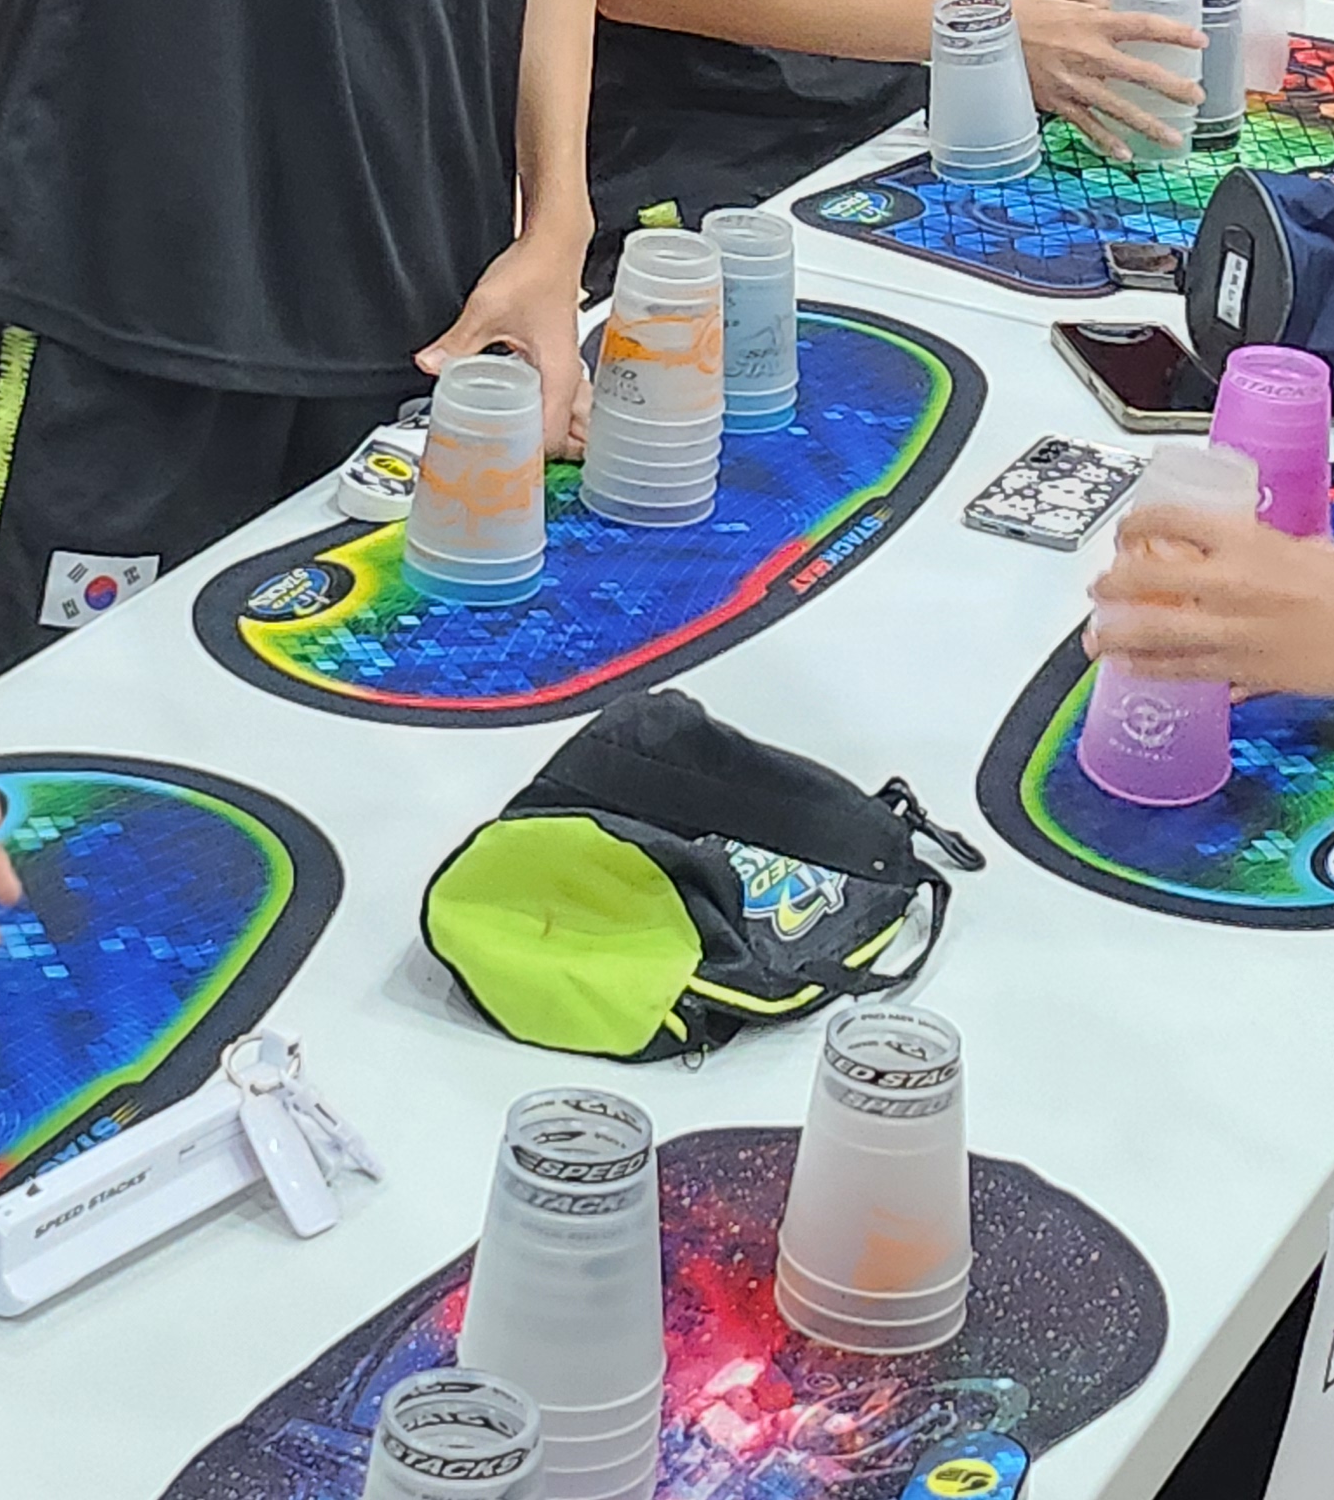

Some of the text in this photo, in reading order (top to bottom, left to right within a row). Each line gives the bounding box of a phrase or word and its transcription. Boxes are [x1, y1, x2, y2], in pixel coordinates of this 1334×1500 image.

[878, 1060, 960, 1088] STAC
[534, 1153, 646, 1182] SPEED
[34, 1171, 146, 1239] SPEED STACKS
[383, 1436, 523, 1478] STACKS
